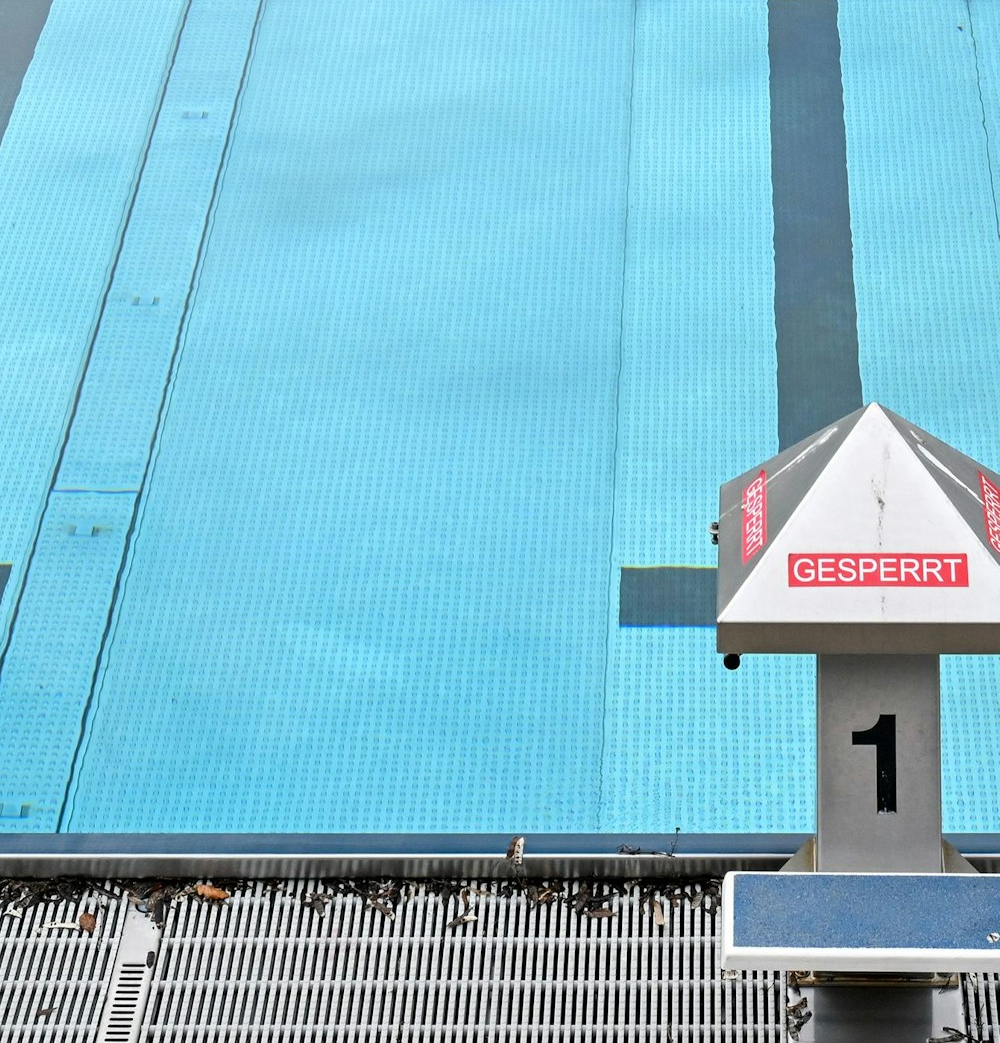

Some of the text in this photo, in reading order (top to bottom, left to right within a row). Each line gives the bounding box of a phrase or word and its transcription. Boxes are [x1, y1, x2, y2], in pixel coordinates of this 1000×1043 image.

[746, 477, 763, 556] GESPERRT
[793, 558, 962, 582] GESPERRT
[852, 714, 897, 814] 1
